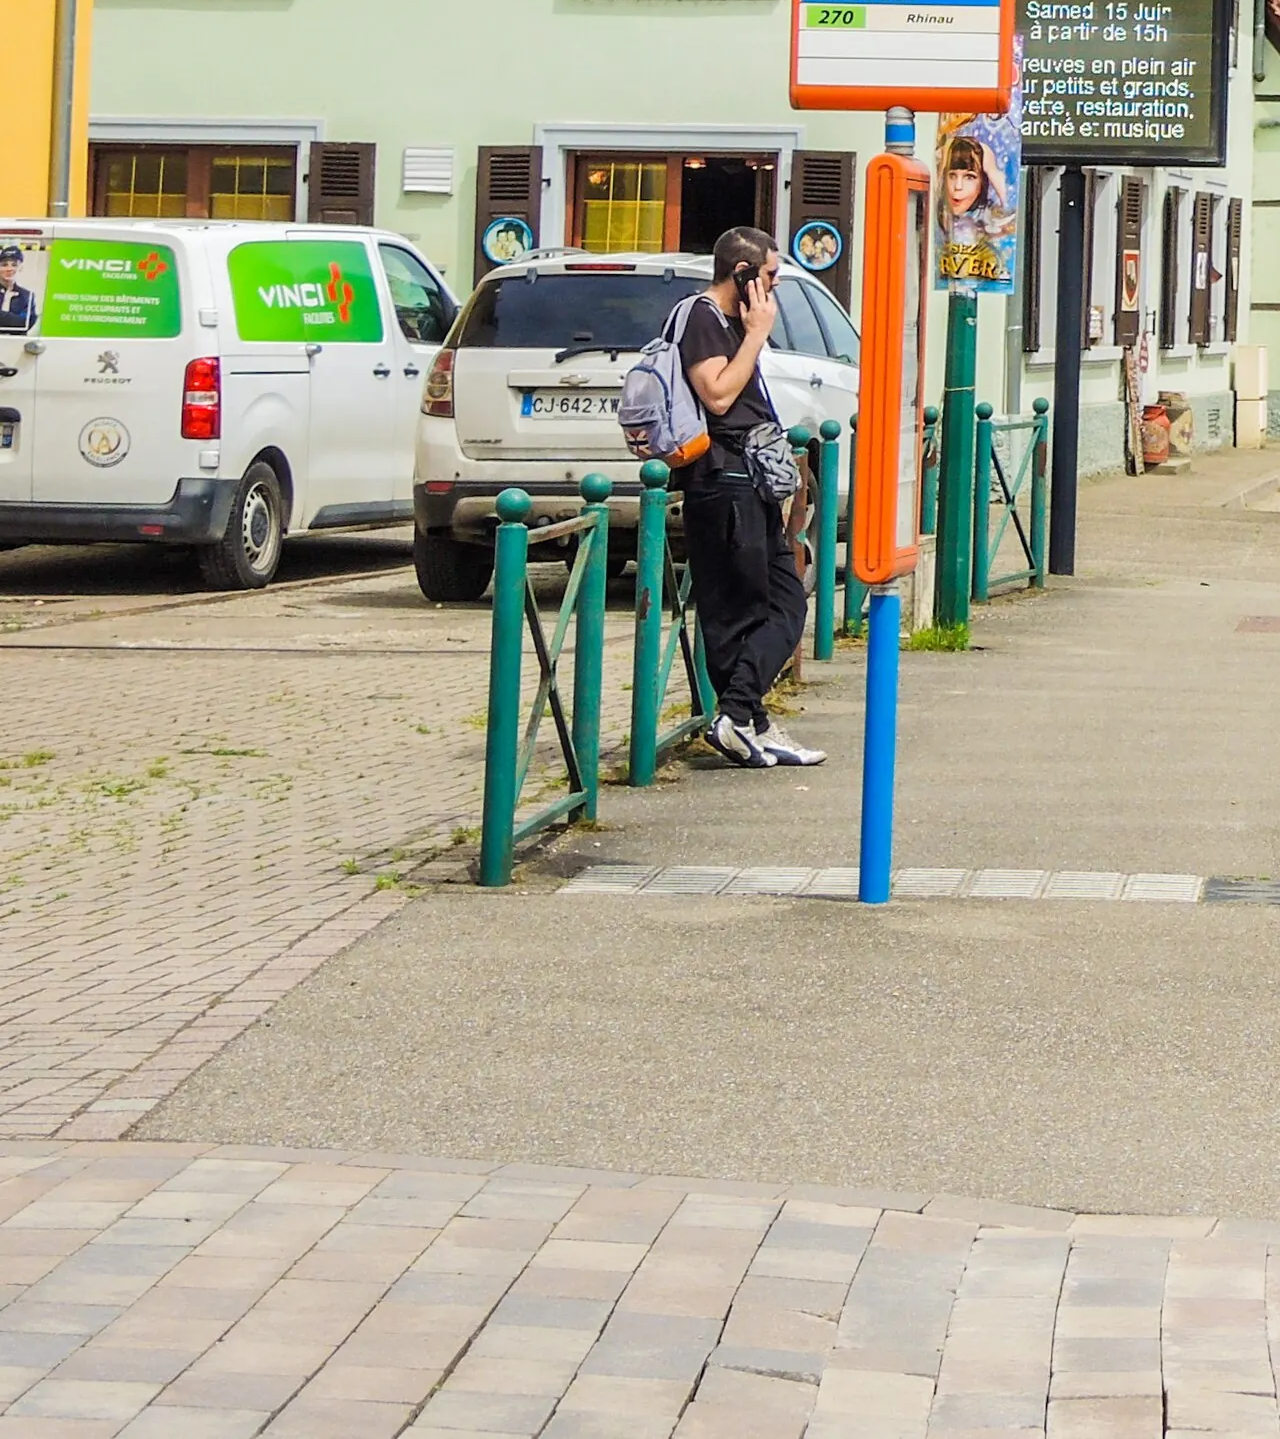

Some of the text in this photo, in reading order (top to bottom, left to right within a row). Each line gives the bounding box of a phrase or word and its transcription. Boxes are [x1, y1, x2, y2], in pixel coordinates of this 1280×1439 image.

[818, 10, 854, 25] 270
[906, 13, 954, 25] Rhinau
[1026, 0, 1098, 20] Samed
[1105, 2, 1128, 21] 15
[1030, 20, 1168, 43] à partir de 15h
[1091, 60, 1115, 75] en
[1121, 57, 1165, 78] plein
[1171, 57, 1196, 76] air
[1043, 77, 1095, 97] petits
[1100, 80, 1118, 96] et
[1021, 116, 1075, 137] arché
[1104, 120, 1185, 142] musique
[60, 258, 132, 272] VINCI
[258, 283, 326, 309] VINCI
[83, 377, 132, 385] PEUGEOT
